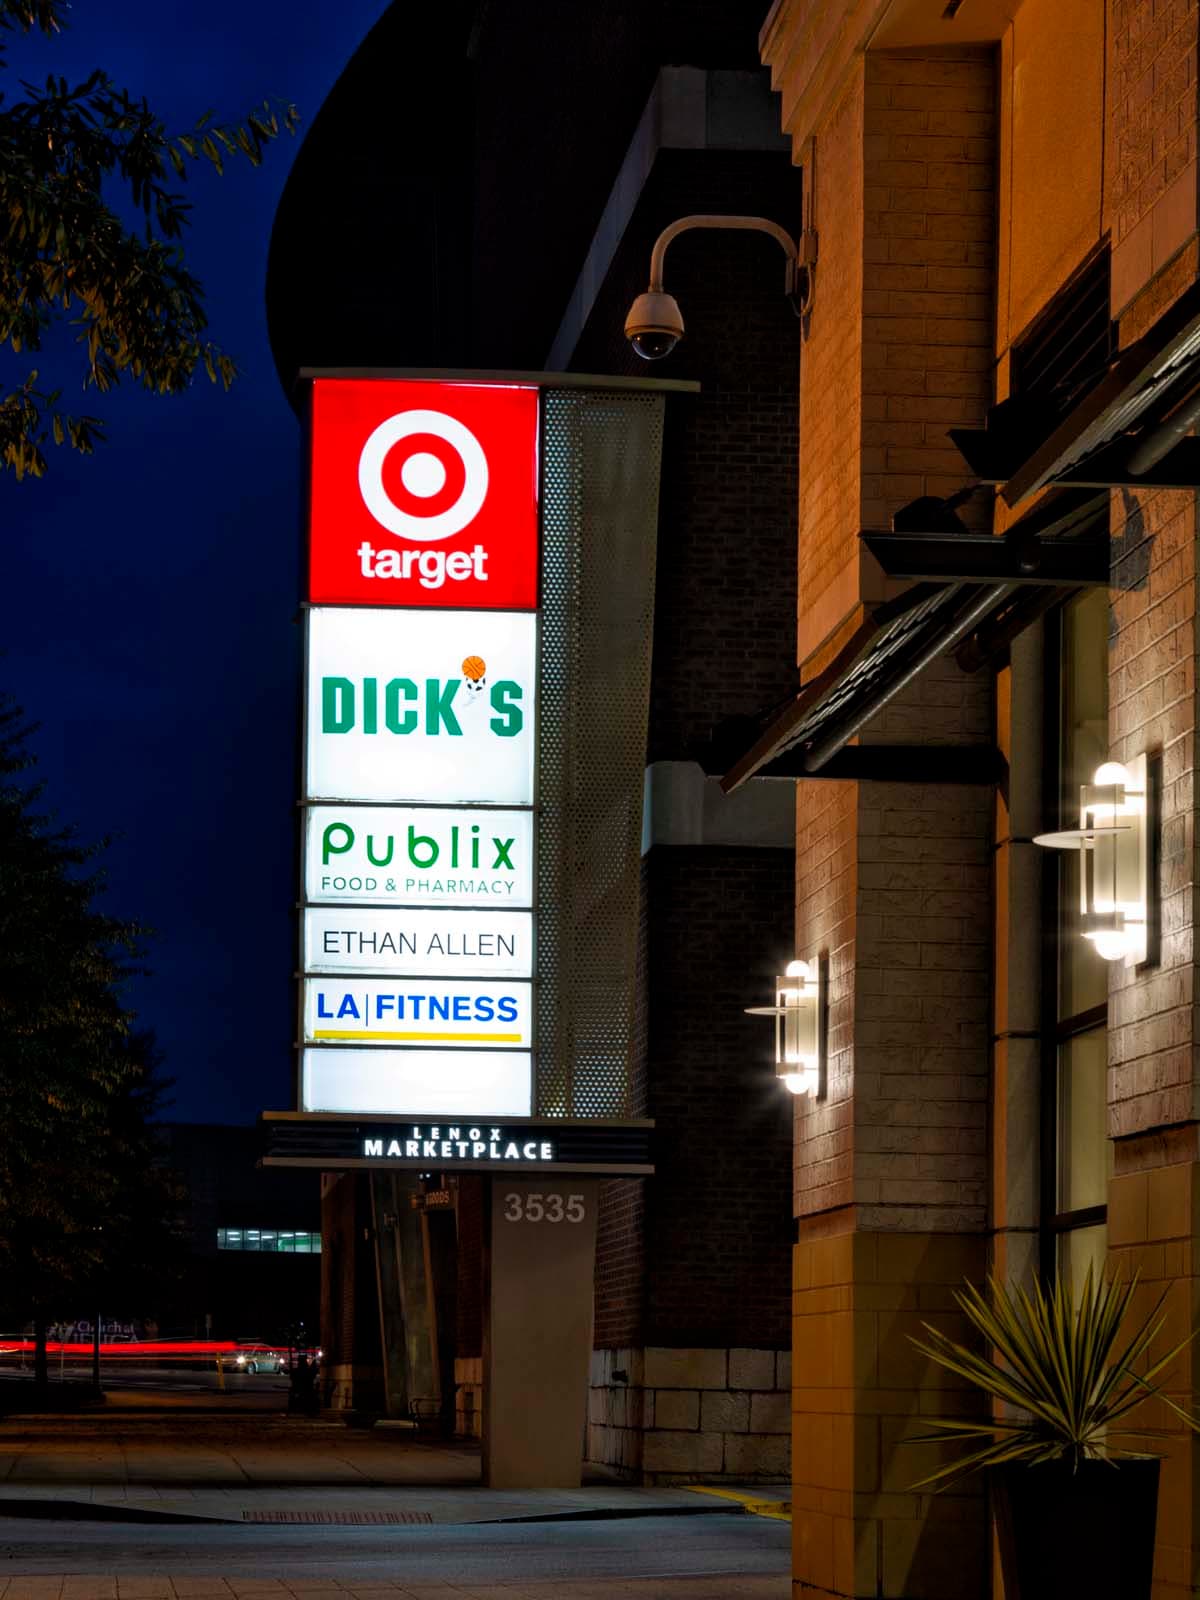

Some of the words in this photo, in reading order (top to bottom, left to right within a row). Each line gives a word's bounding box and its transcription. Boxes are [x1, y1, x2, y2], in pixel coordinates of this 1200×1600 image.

[357, 541, 488, 589] target
[322, 822, 515, 870] Publix
[321, 876, 378, 891] FOOD
[385, 878, 397, 893] &
[405, 878, 514, 895] PHARMACY
[323, 931, 417, 955] ETHAN
[427, 933, 515, 957] ALLEN
[317, 993, 361, 1020] LA
[376, 994, 518, 1023] FITNESS
[413, 1127, 501, 1141] LENOX
[364, 1139, 553, 1160] MARKETPLACE
[503, 1193, 585, 1222] 3535
